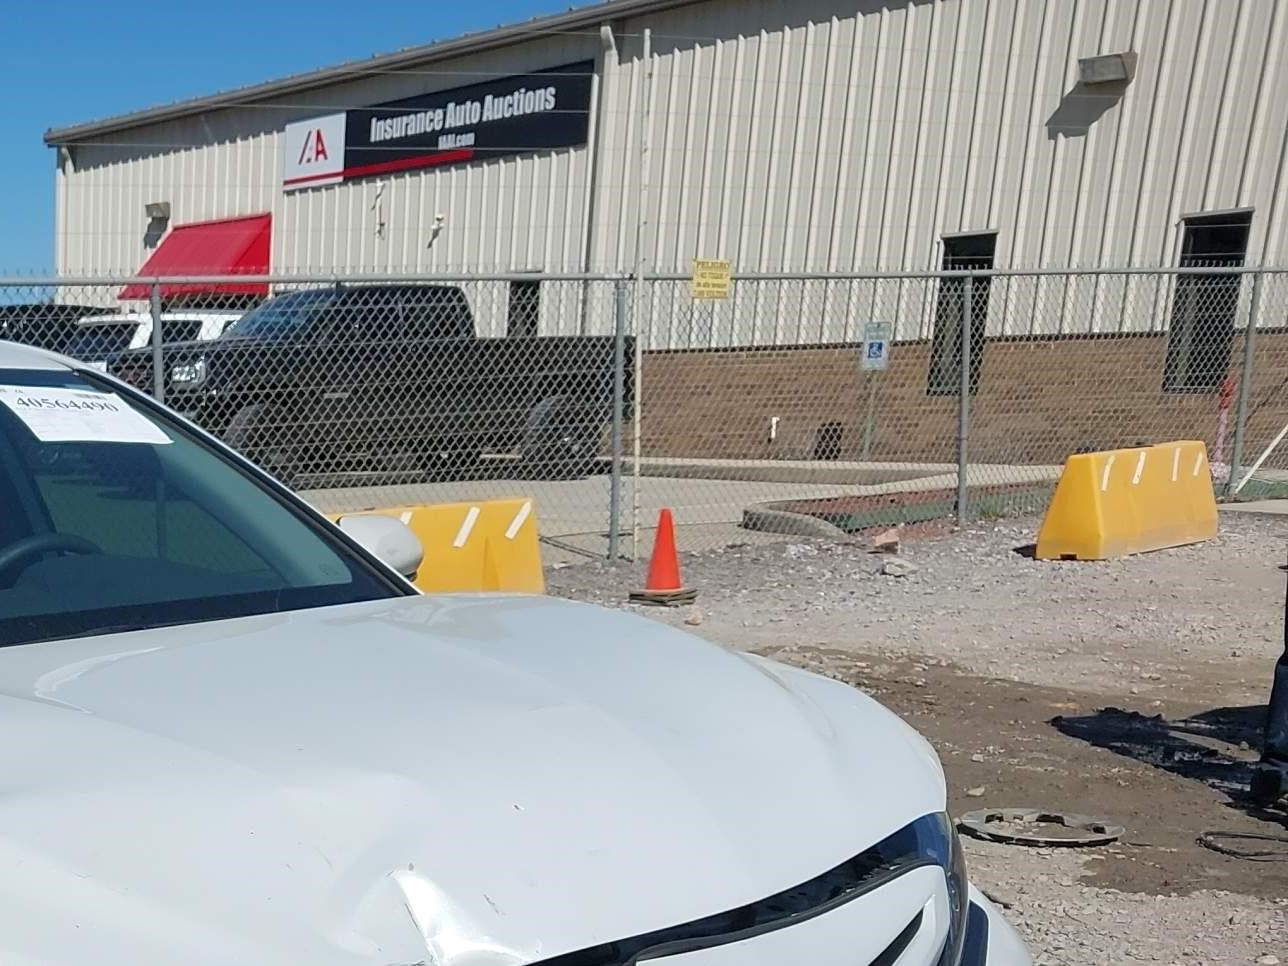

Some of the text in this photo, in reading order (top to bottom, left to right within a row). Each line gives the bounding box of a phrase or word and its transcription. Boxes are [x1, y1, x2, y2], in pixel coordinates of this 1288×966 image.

[370, 87, 556, 142] Insurance Auto Auctions
